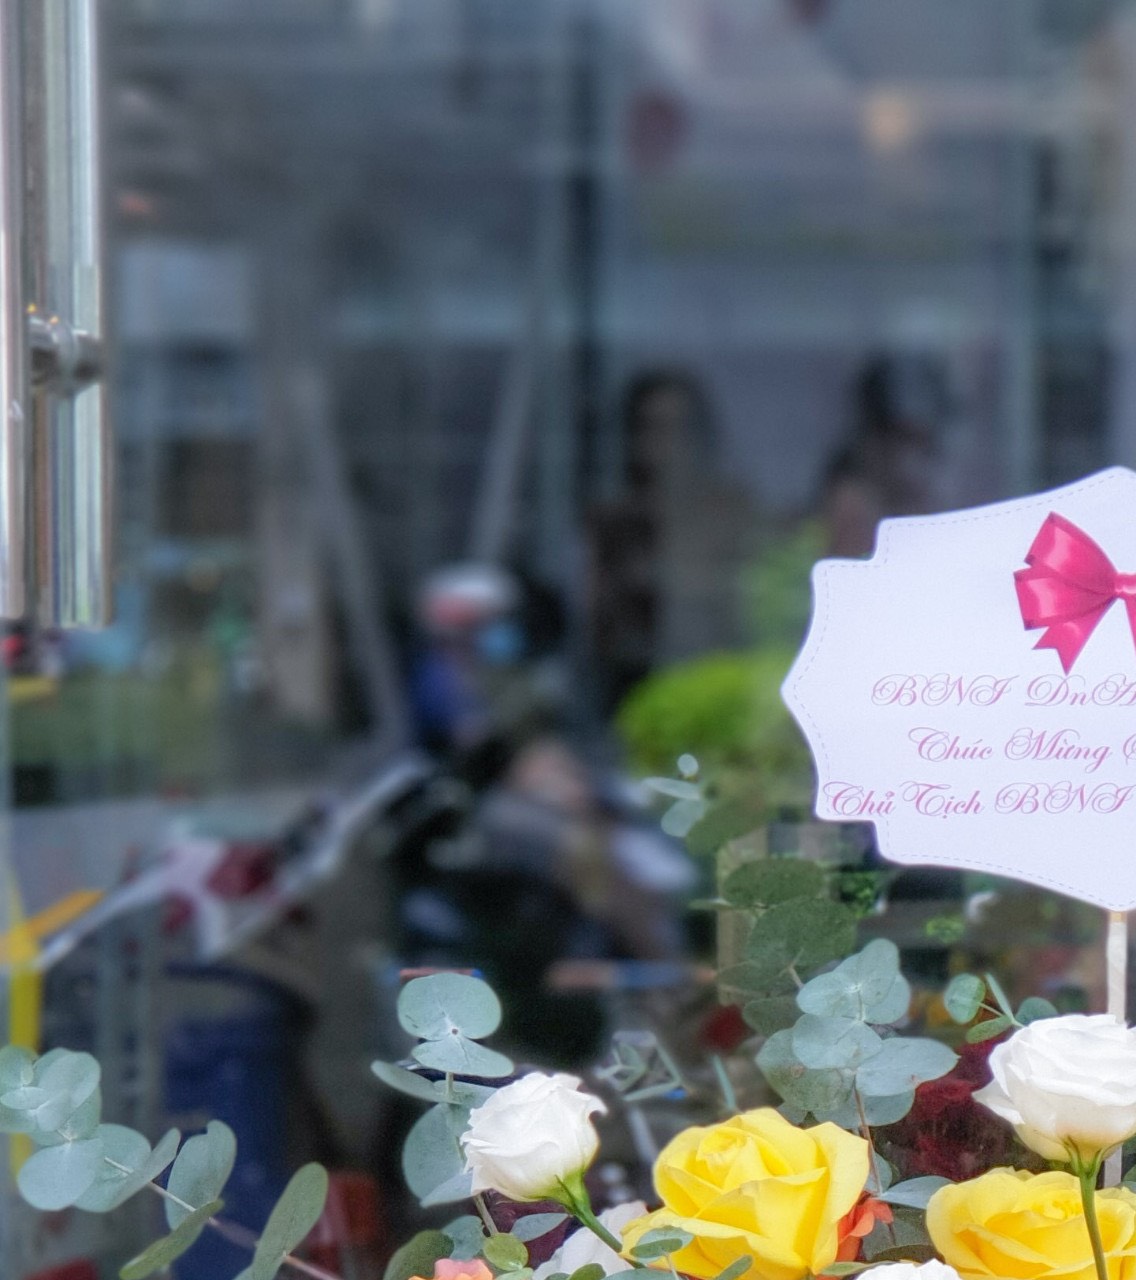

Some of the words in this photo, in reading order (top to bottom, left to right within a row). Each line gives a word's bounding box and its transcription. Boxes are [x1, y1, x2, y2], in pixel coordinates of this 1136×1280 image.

[871, 673, 1019, 706] BNI
[908, 727, 993, 762] Chúc
[1004, 727, 1111, 773] Mừng
[823, 781, 895, 815] Chủ
[900, 780, 982, 819] Tịch
